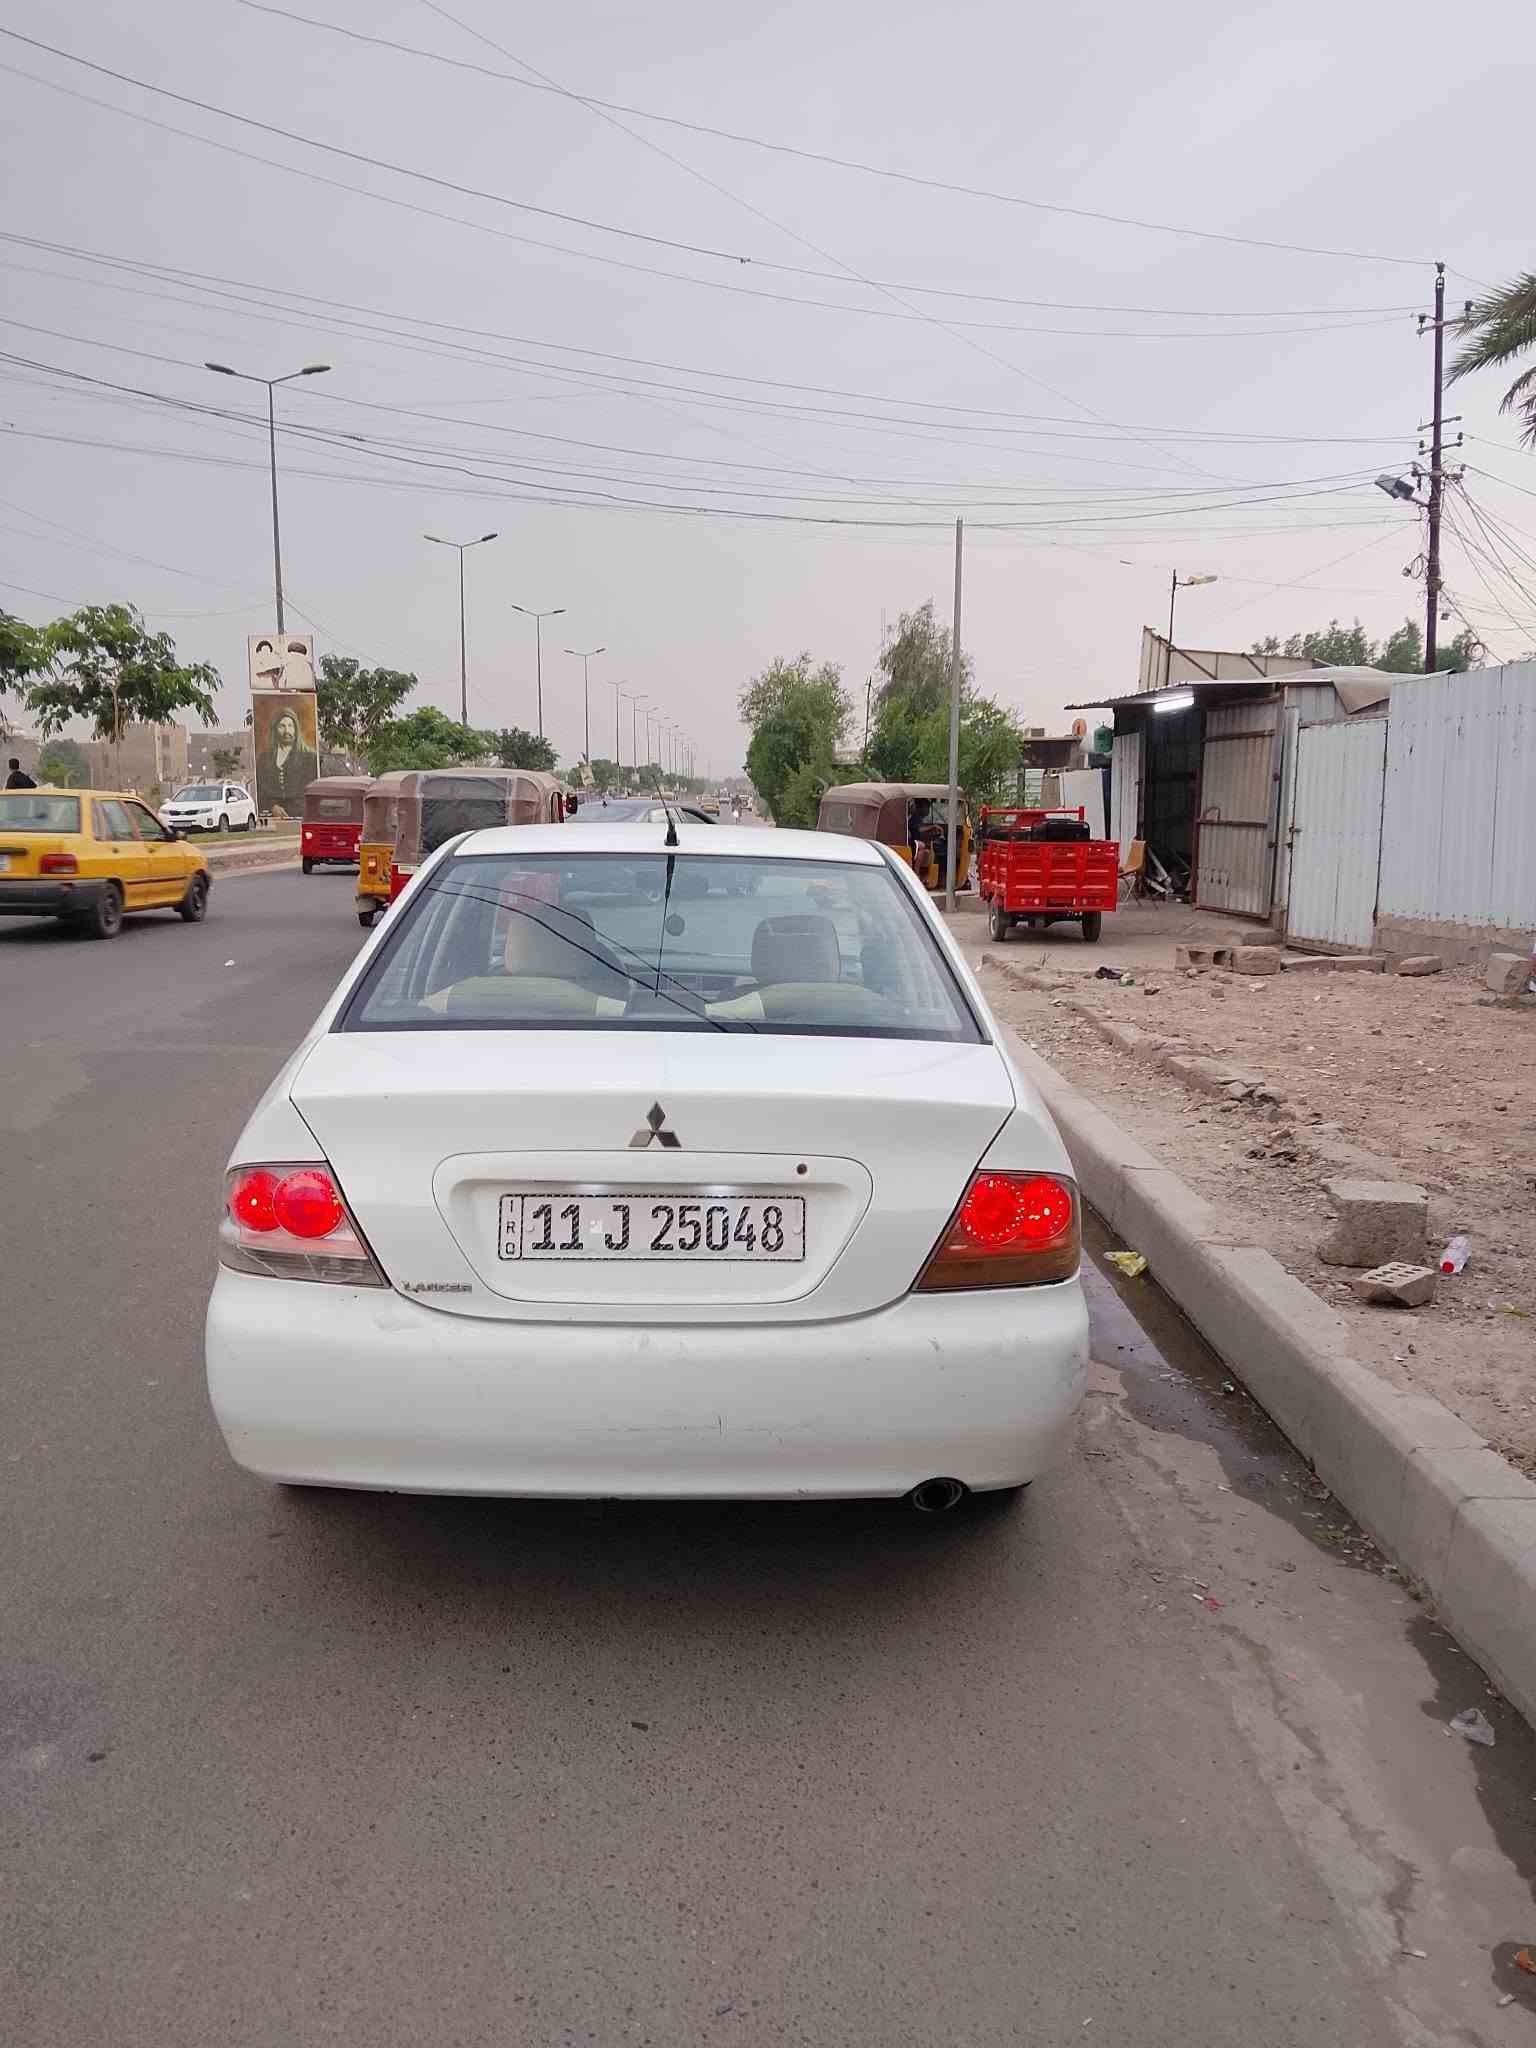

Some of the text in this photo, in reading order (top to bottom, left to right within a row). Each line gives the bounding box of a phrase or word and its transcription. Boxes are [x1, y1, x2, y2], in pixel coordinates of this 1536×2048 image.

[531, 1203, 785, 1252] 11 J 25048
